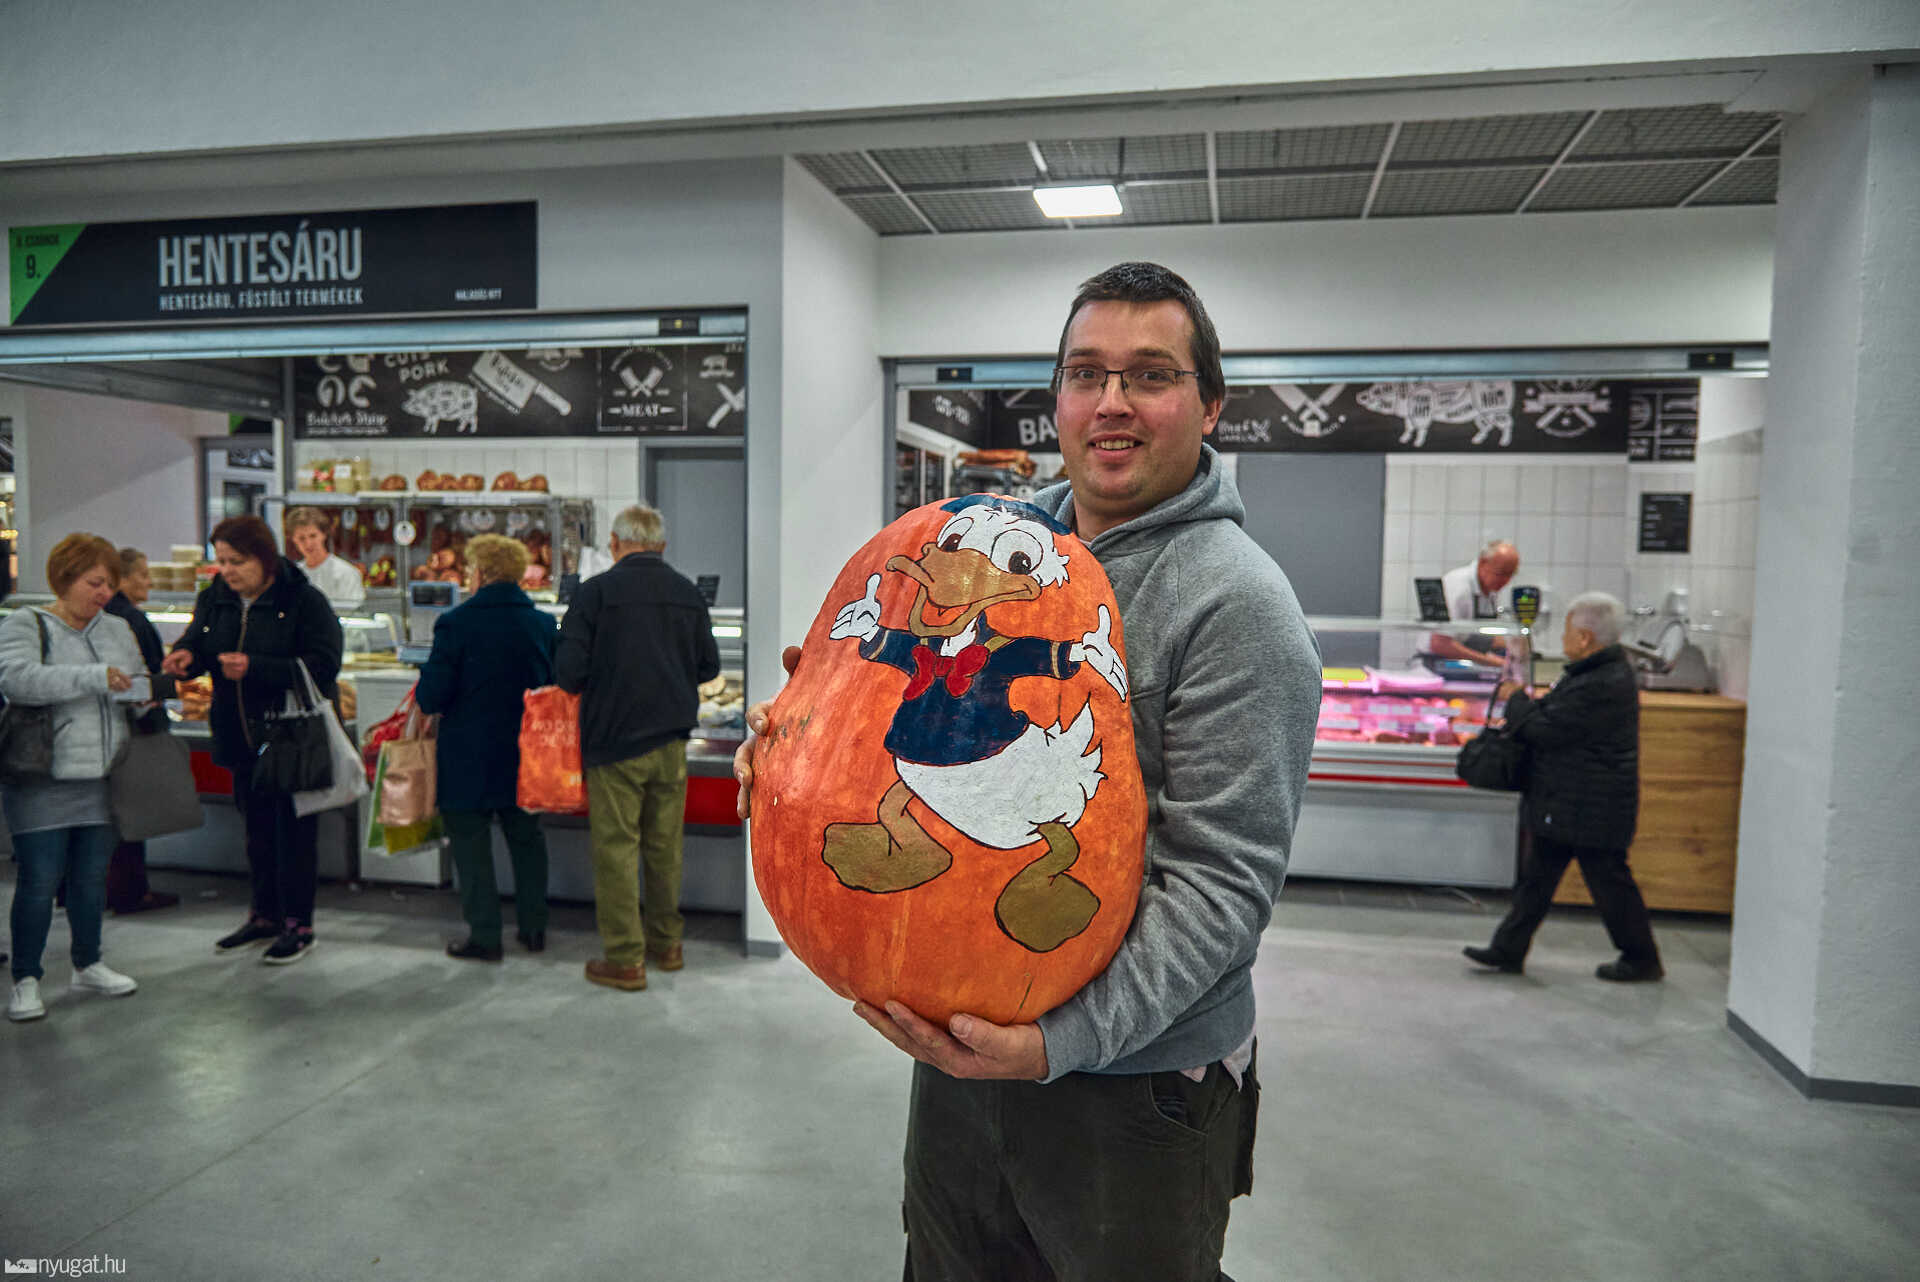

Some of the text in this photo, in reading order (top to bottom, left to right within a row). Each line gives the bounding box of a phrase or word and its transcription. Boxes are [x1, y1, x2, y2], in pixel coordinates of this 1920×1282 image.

[159, 221, 363, 288] HENTESÁRU
[399, 359, 450, 383] PORK
[621, 403, 661, 417] MEAT
[1018, 413, 1058, 446] BA
